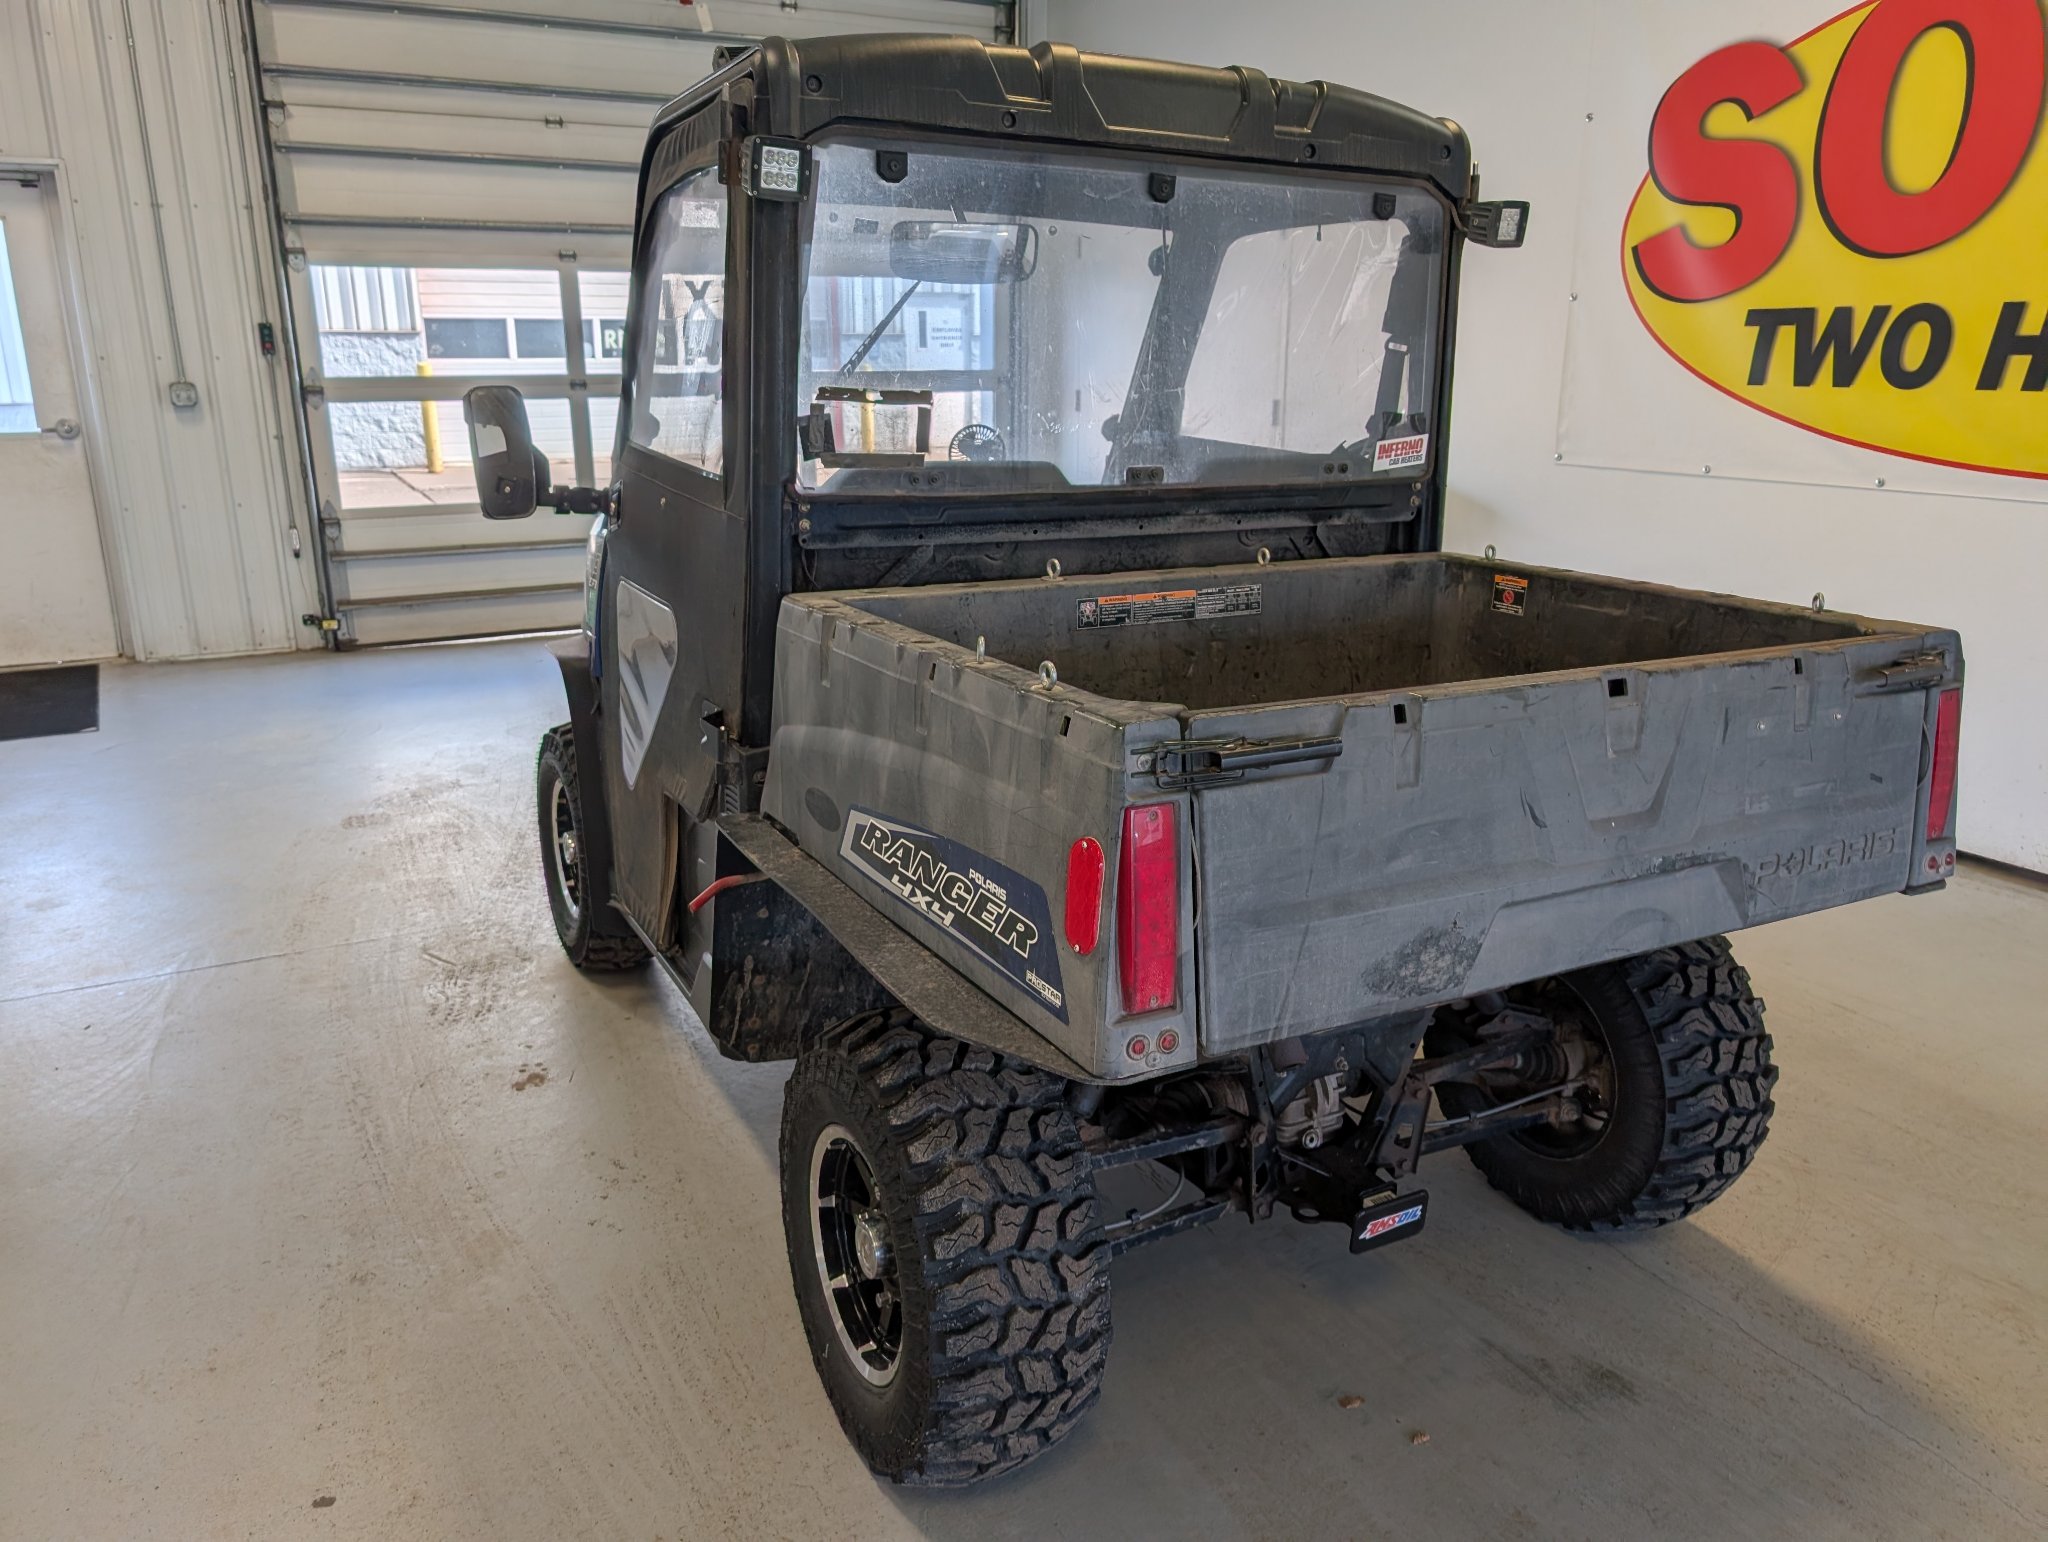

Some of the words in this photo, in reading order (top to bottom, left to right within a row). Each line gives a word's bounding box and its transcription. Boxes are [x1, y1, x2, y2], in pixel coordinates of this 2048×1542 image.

[1744, 302, 1952, 390] TWO
[1377, 438, 1424, 460] INFERNO
[1755, 827, 1896, 885] POLARIS
[860, 819, 1039, 959] RANGER
[968, 868, 1007, 902] POLARIS
[1026, 970, 1061, 1006] PROSTAR
[1360, 1205, 1422, 1239] AMSOIL
